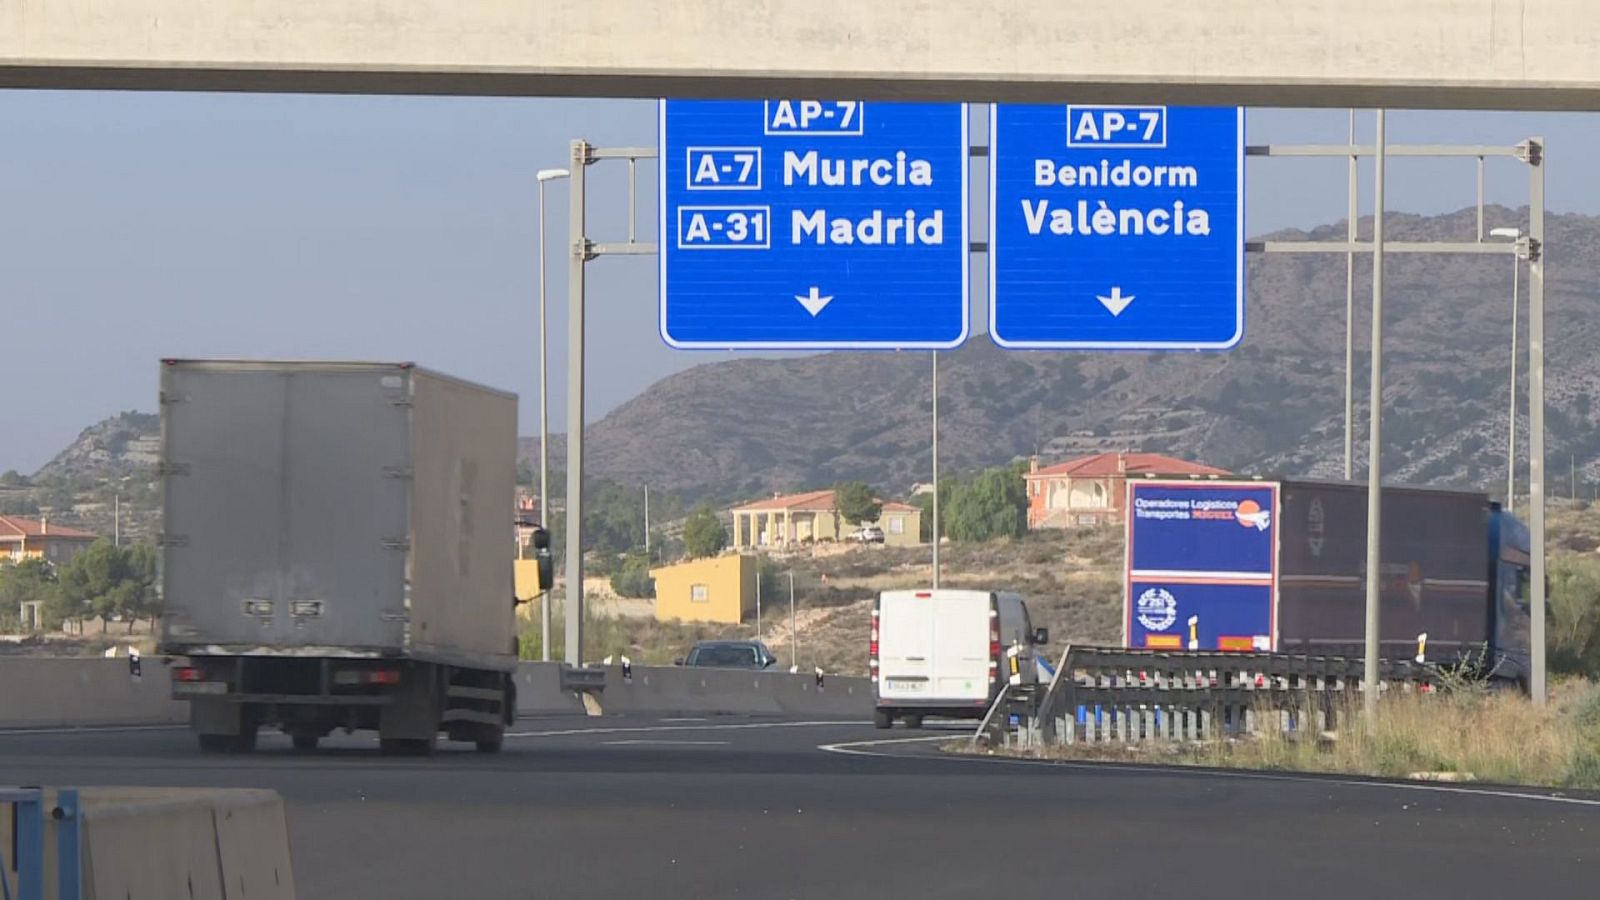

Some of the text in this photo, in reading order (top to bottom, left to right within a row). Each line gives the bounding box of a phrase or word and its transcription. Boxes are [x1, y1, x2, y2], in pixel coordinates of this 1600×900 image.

[772, 100, 857, 129] AP-7
[1073, 111, 1160, 140] AP-7
[694, 150, 934, 186] A-7 Murcia
[1035, 158, 1198, 187] Benidorm
[686, 209, 943, 245] A-31 Madrid
[1021, 199, 1211, 236] València
[1135, 498, 1190, 509] Operadores
[1136, 508, 1190, 519] Transportes
